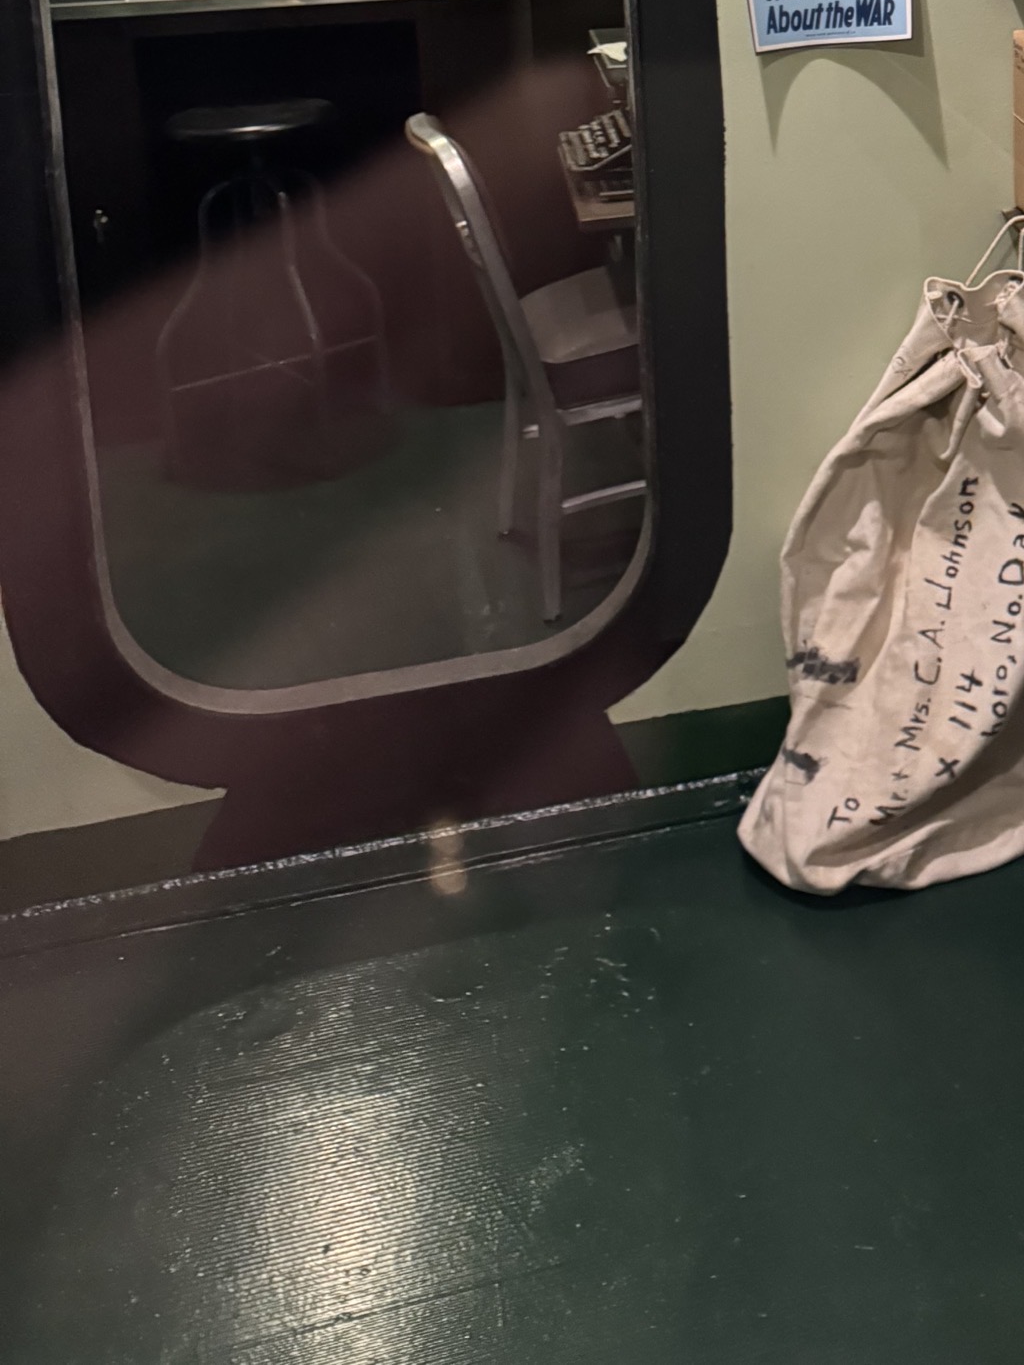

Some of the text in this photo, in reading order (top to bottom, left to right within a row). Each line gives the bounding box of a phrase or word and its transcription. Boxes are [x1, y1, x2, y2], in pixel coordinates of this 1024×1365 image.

[766, 2, 824, 35] About
[826, 0, 854, 30] the
[990, 593, 1024, 644] No.
[868, 789, 910, 826] Mr.
[893, 697, 932, 751] Mrs.
[923, 476, 980, 611] Johnson
[948, 668, 984, 730] 114
[826, 797, 861, 830] To
